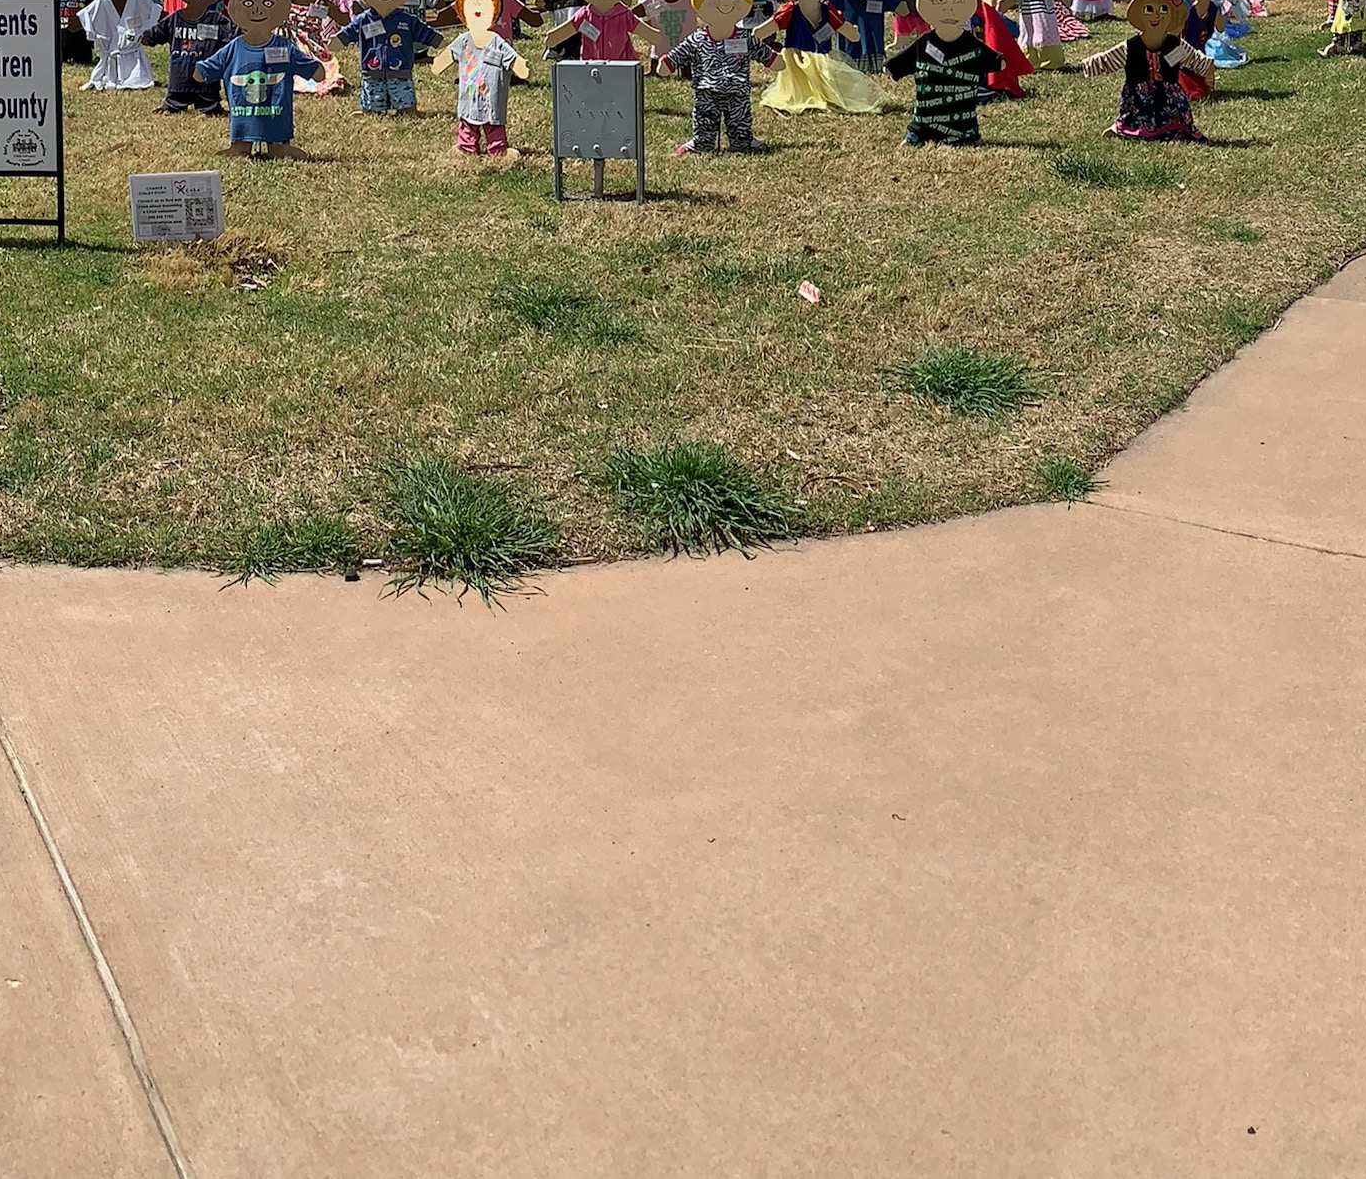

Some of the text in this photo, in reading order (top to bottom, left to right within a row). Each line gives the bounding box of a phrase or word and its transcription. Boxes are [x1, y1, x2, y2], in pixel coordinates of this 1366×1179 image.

[175, 27, 203, 41] KIN
[949, 57, 959, 66] NOT
[960, 50, 976, 63] PINCH
[926, 63, 944, 73] PINCH
[955, 70, 963, 79] DO
[963, 73, 973, 81] NOT
[954, 85, 971, 93] PINCH
[955, 90, 974, 101] DO NOT
[925, 97, 943, 107] PINCH
[253, 105, 284, 117] BOUNTY
[921, 115, 933, 123] NOT
[933, 114, 951, 123] PINCH
[936, 124, 948, 134] NOT
